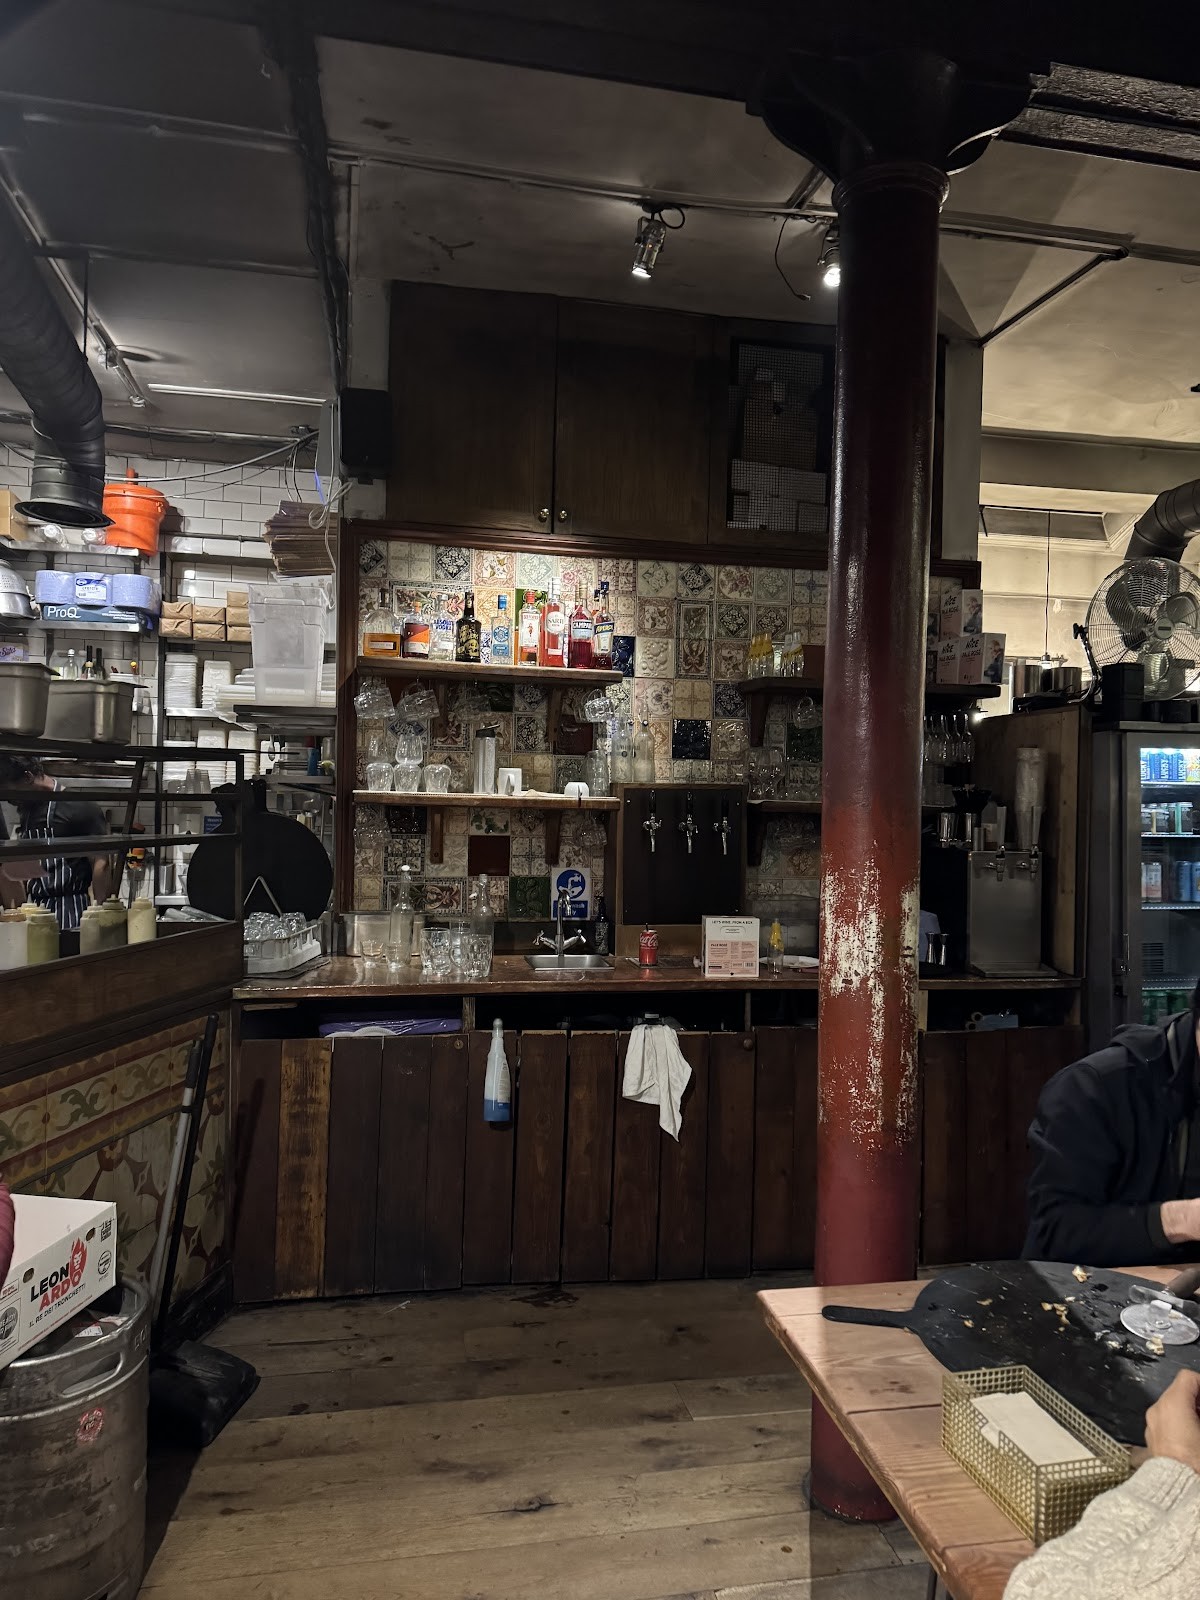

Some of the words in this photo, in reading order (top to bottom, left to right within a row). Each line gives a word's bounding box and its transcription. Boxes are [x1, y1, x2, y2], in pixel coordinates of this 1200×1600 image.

[47, 605, 82, 619] ProQ
[30, 1262, 70, 1303] LEON
[39, 1271, 83, 1312] ARDO
